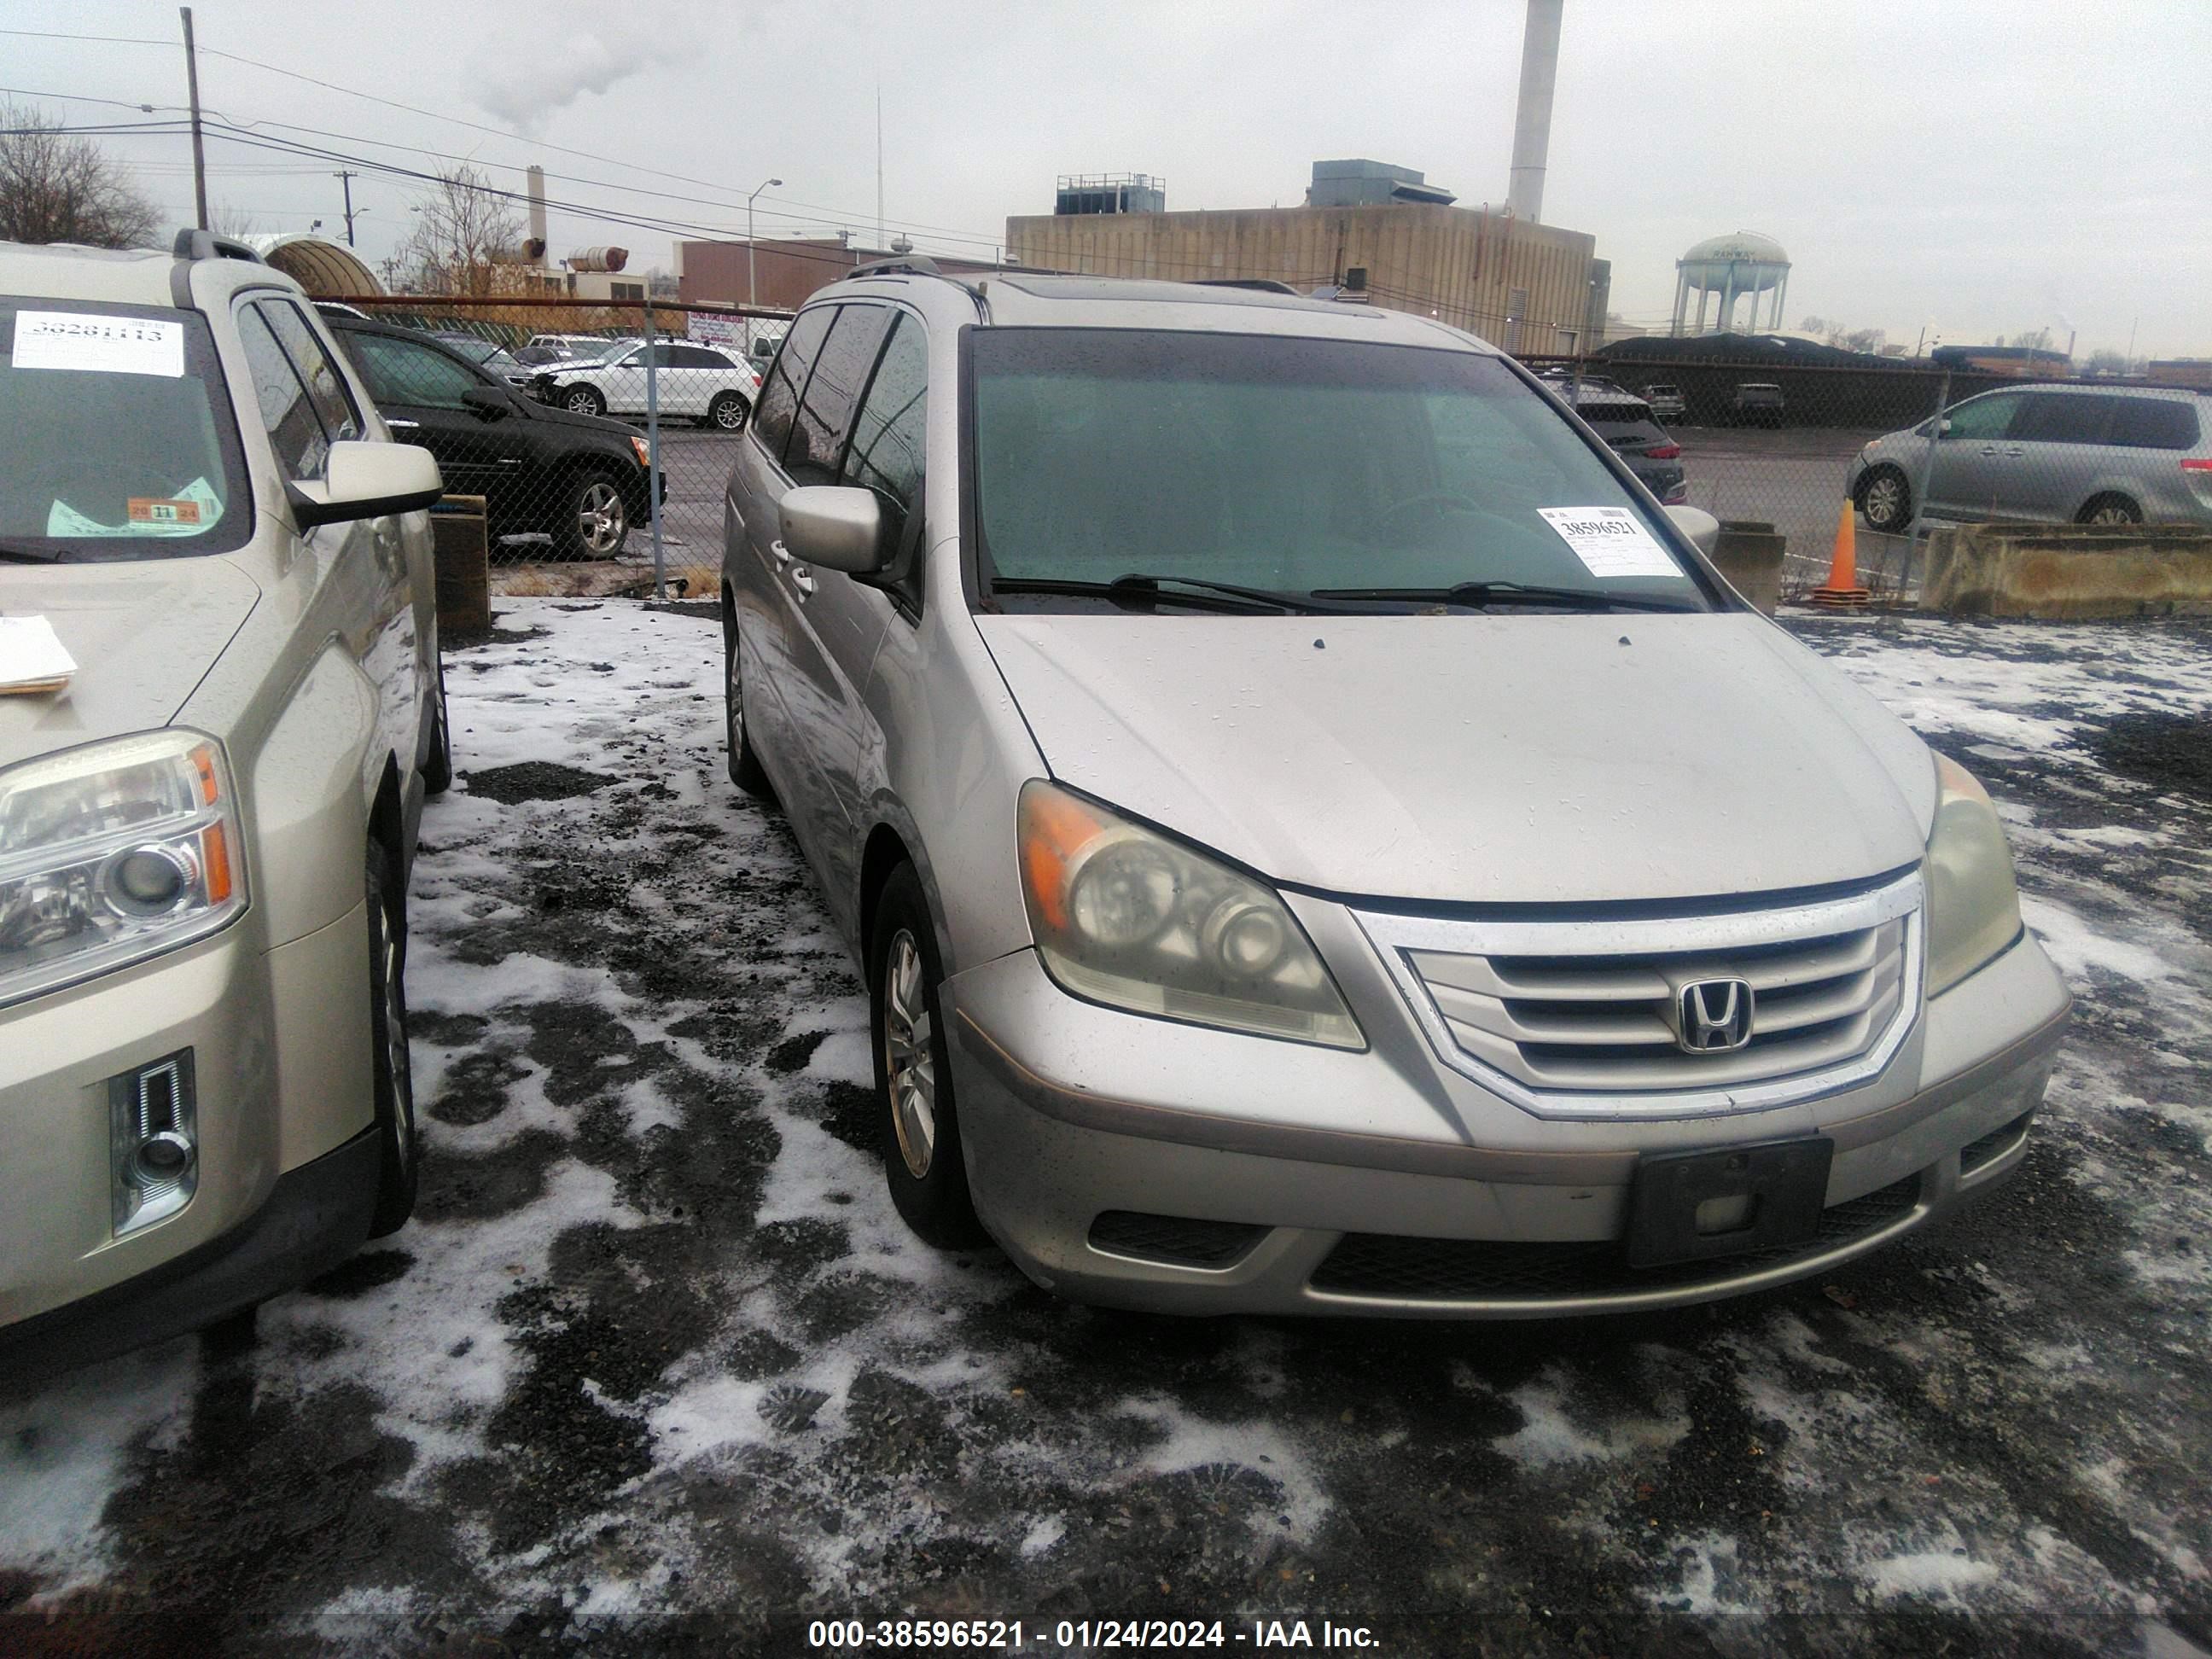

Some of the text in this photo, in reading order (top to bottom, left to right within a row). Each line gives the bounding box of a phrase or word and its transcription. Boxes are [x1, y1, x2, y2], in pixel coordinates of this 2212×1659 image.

[1714, 250, 1755, 259] RAHWAY
[154, 505, 172, 518] 11
[1561, 521, 1637, 536] 38596521
